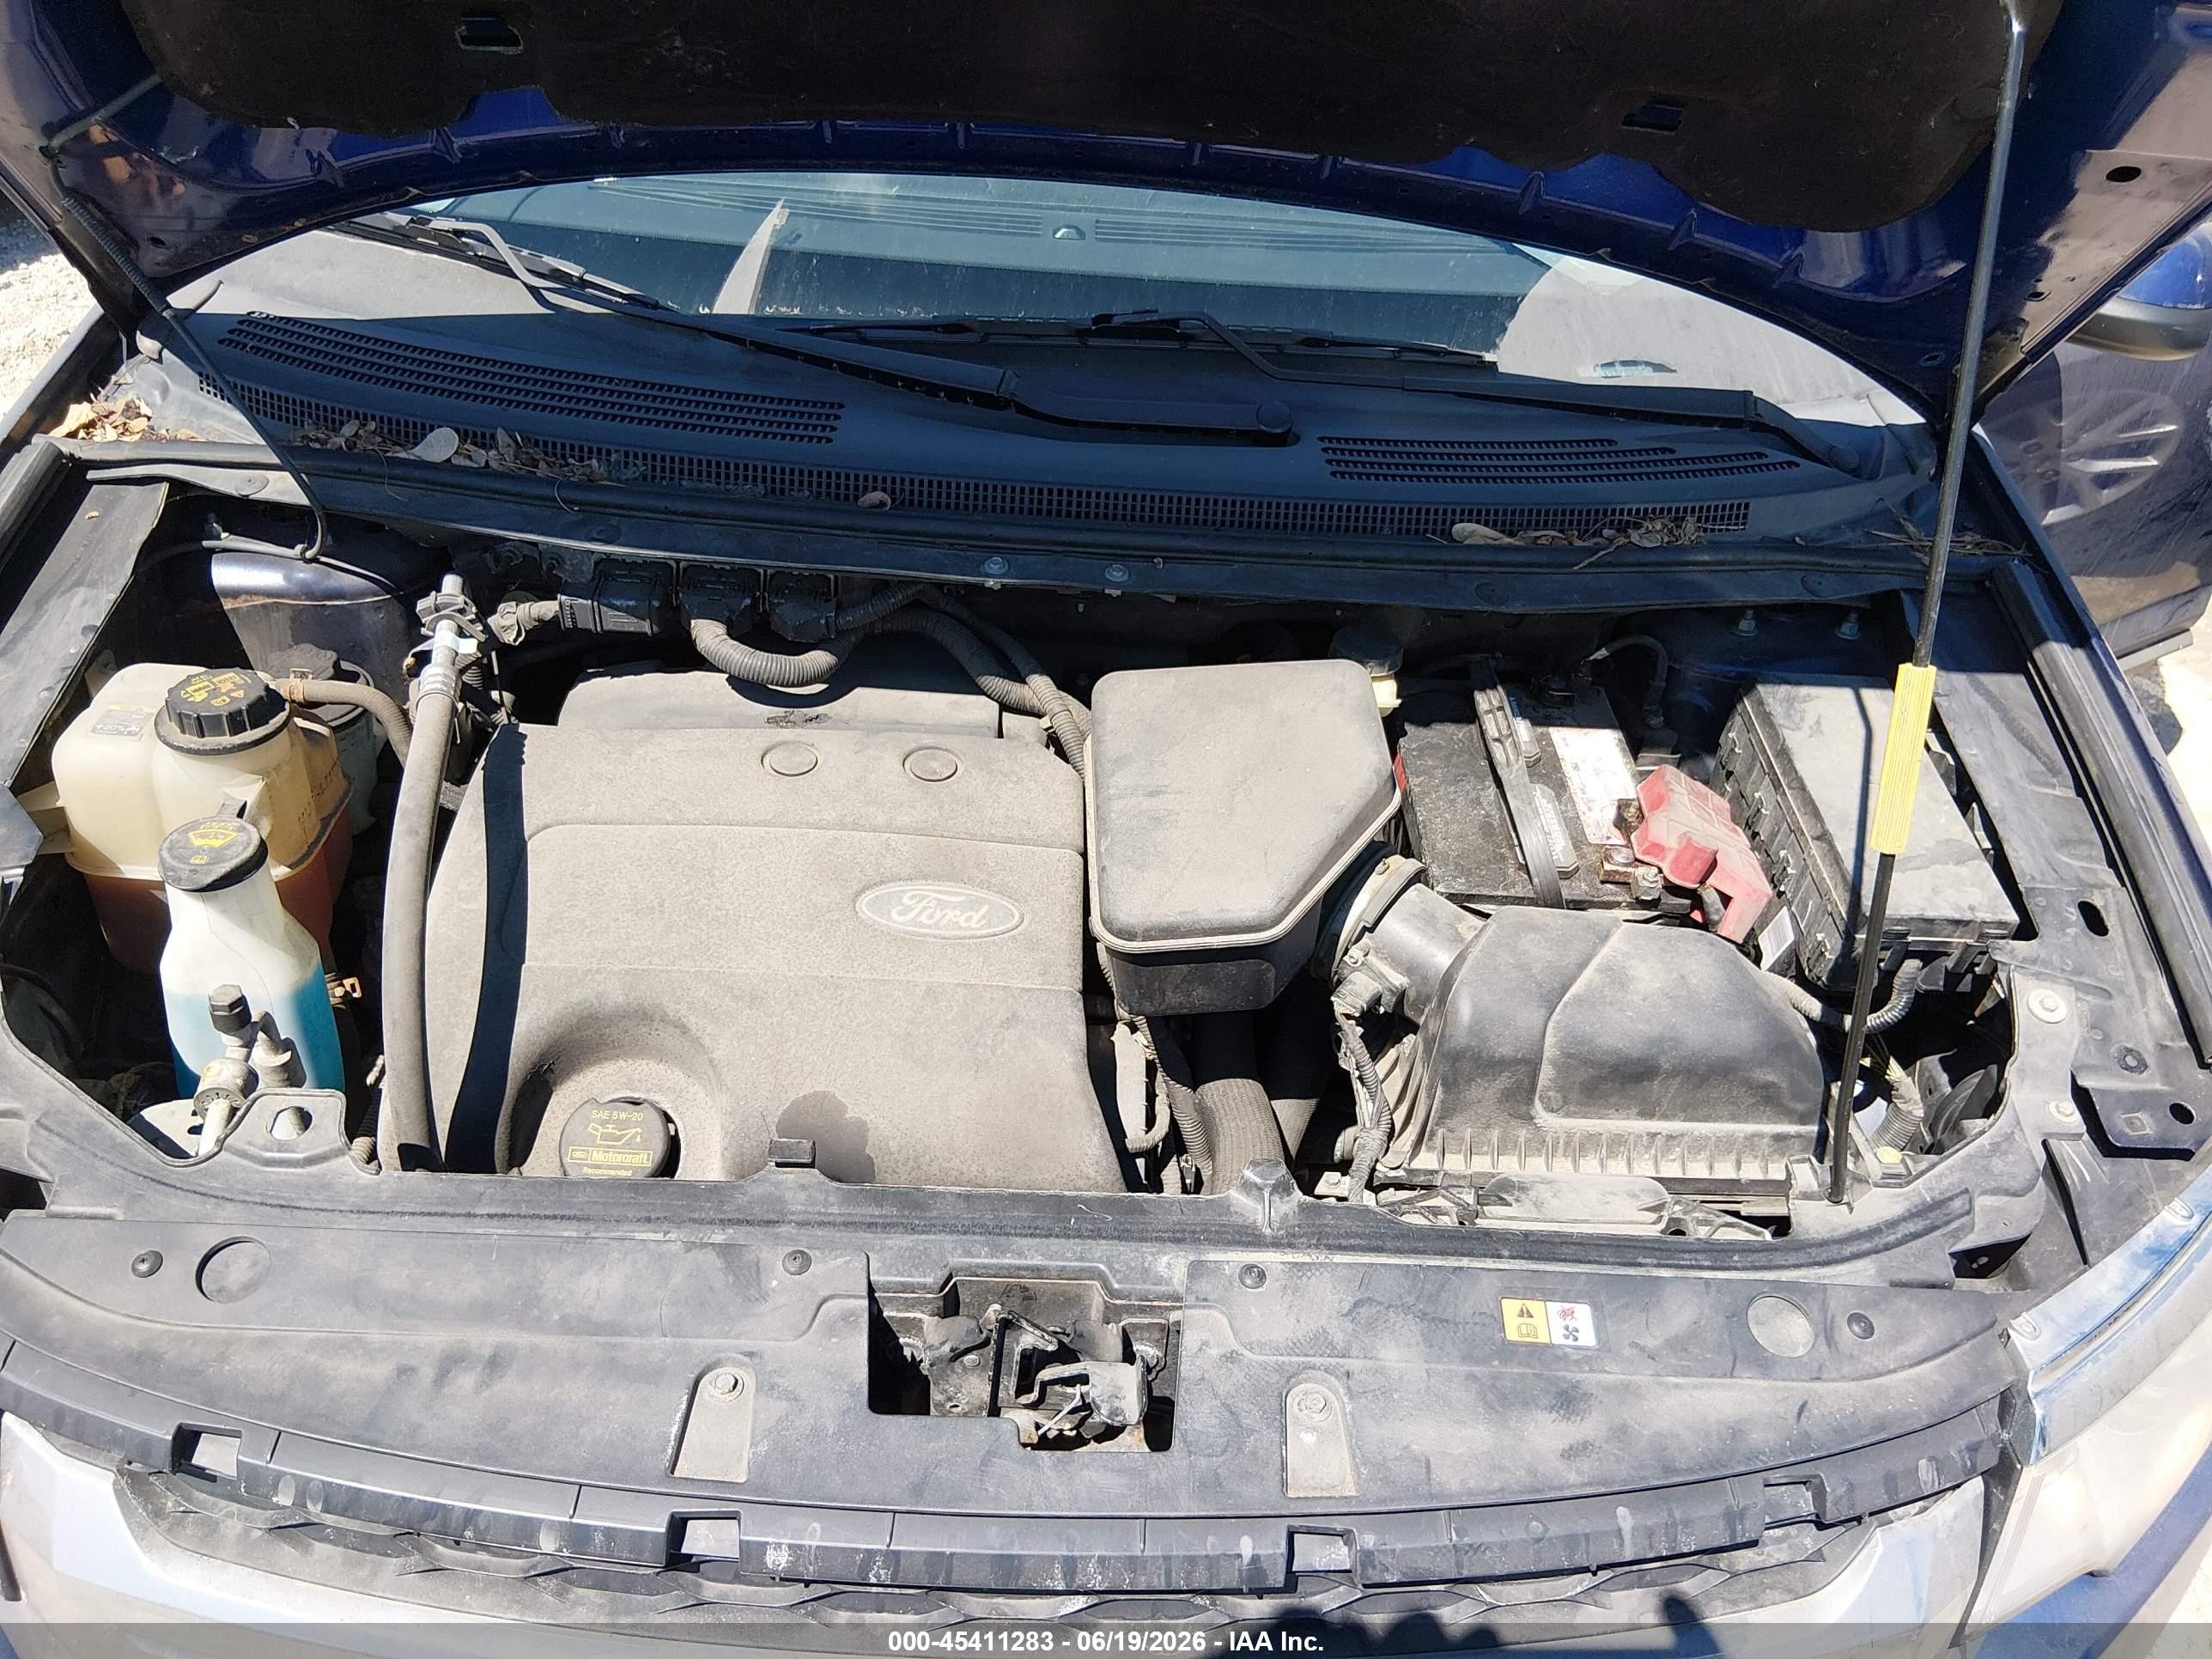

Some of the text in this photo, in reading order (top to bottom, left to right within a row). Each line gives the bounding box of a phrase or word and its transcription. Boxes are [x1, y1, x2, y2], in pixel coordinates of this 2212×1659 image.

[891, 890, 990, 928] Ford
[591, 1109, 611, 1120] SAE
[592, 1150, 649, 1164] Motorcraft
[582, 1166, 633, 1176] Recommended
